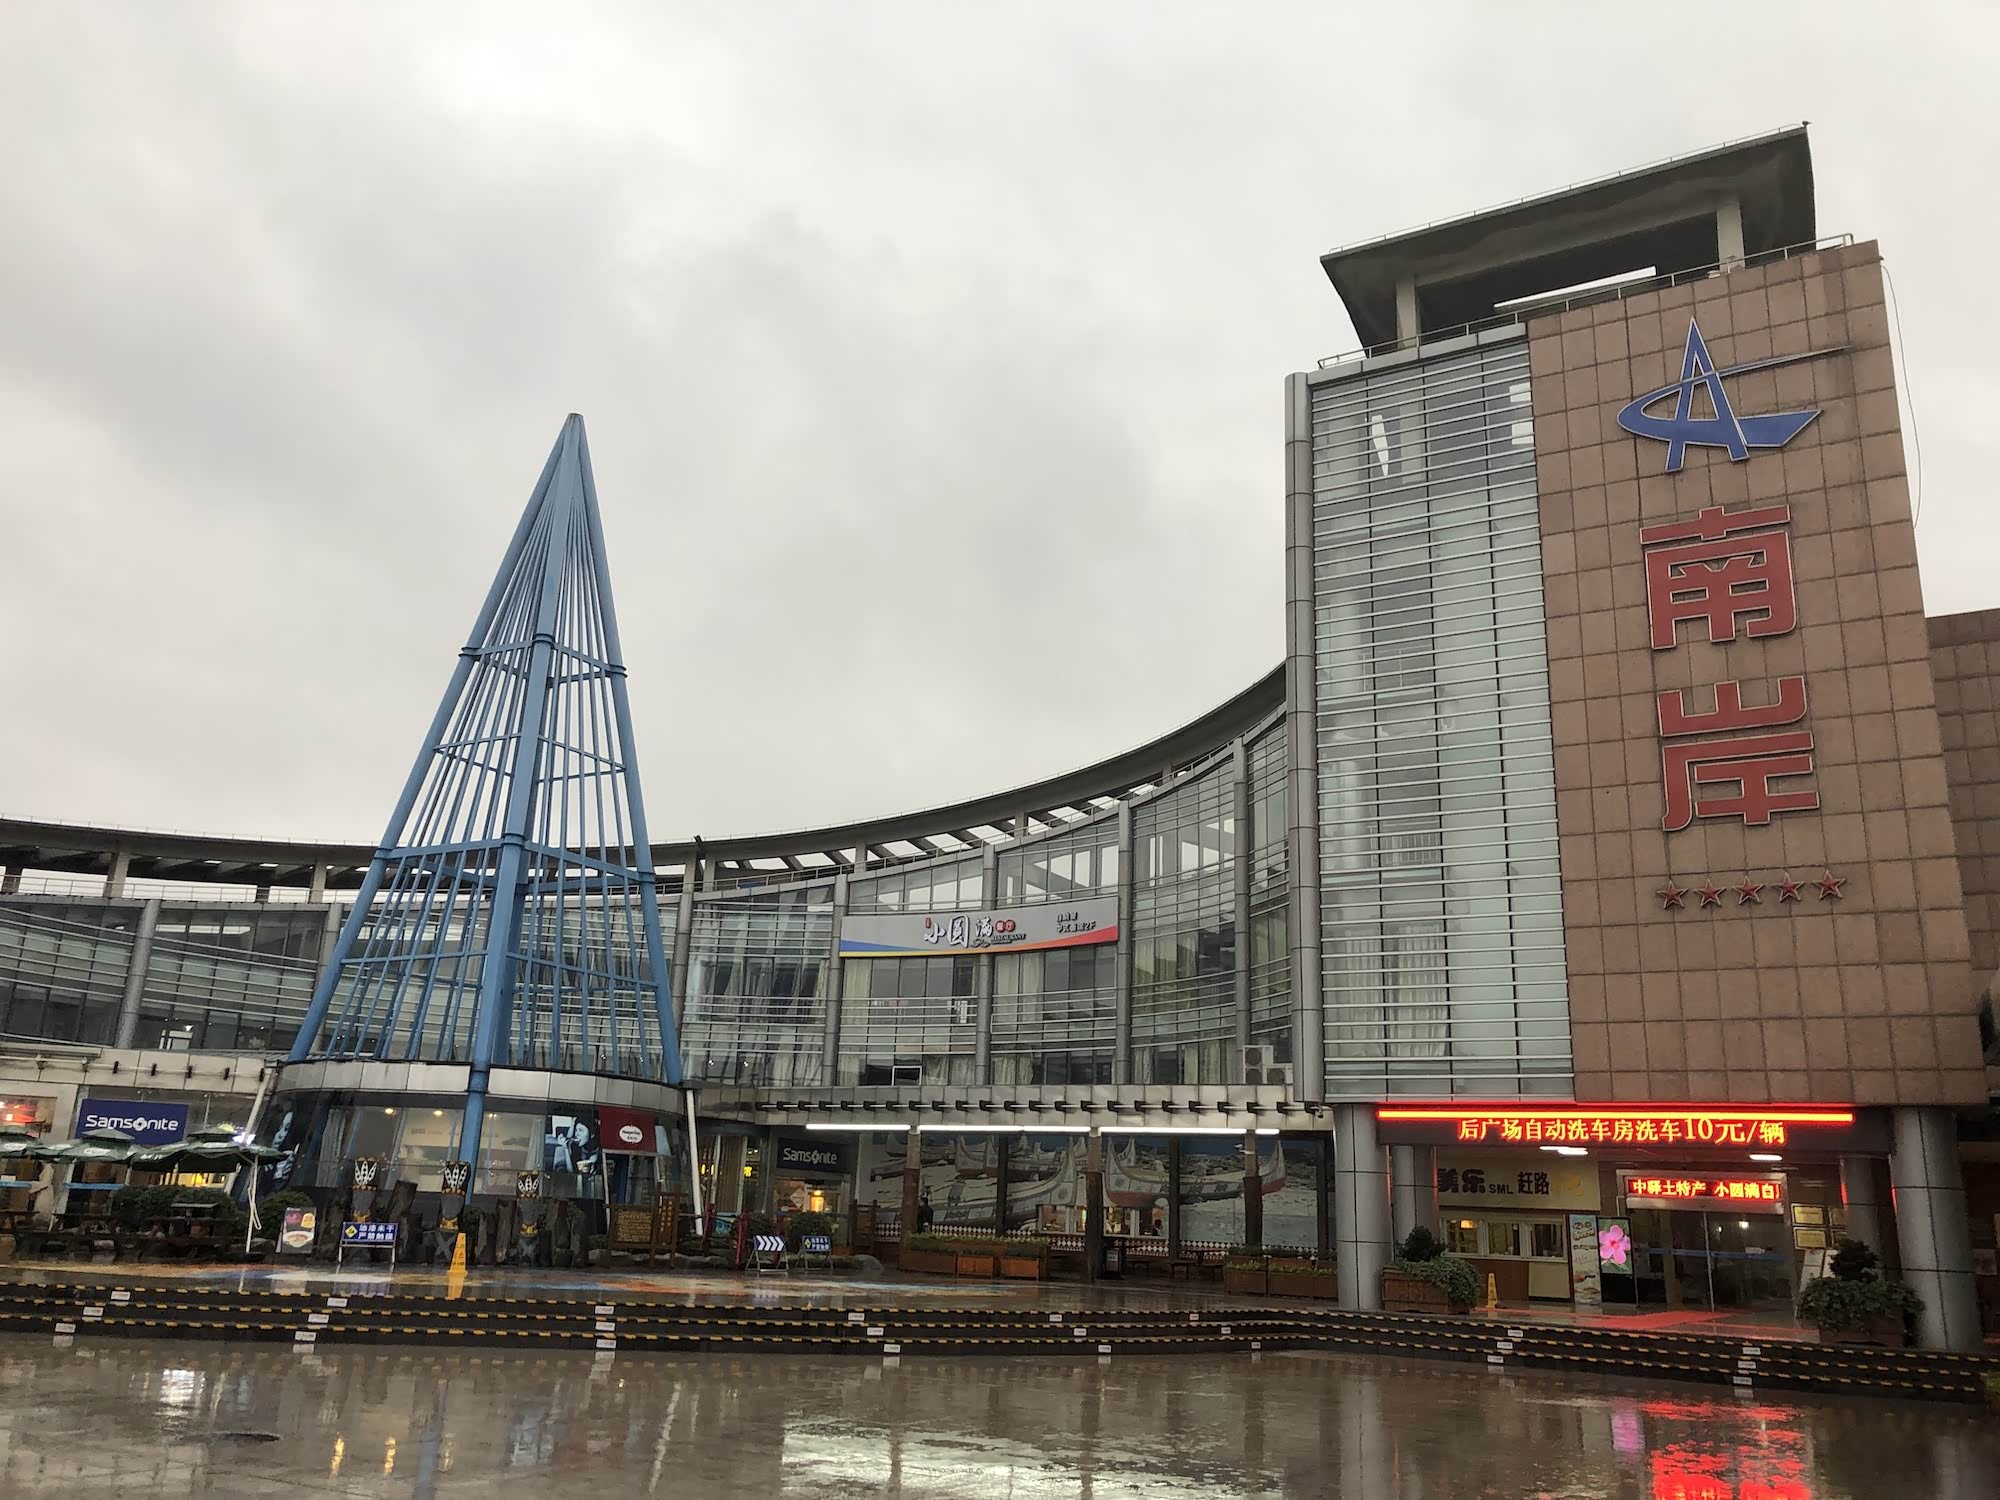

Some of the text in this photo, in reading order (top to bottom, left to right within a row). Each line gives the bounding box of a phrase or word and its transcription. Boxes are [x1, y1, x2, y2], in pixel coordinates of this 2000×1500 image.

[1640, 504, 1820, 832] 南岸
[85, 1114, 179, 1132] Samsonite
[1459, 1118, 1786, 1144] 后广场自动洗车房洗车10元/辆
[783, 1147, 838, 1165] Samsonite
[1489, 1184, 1514, 1195] SML
